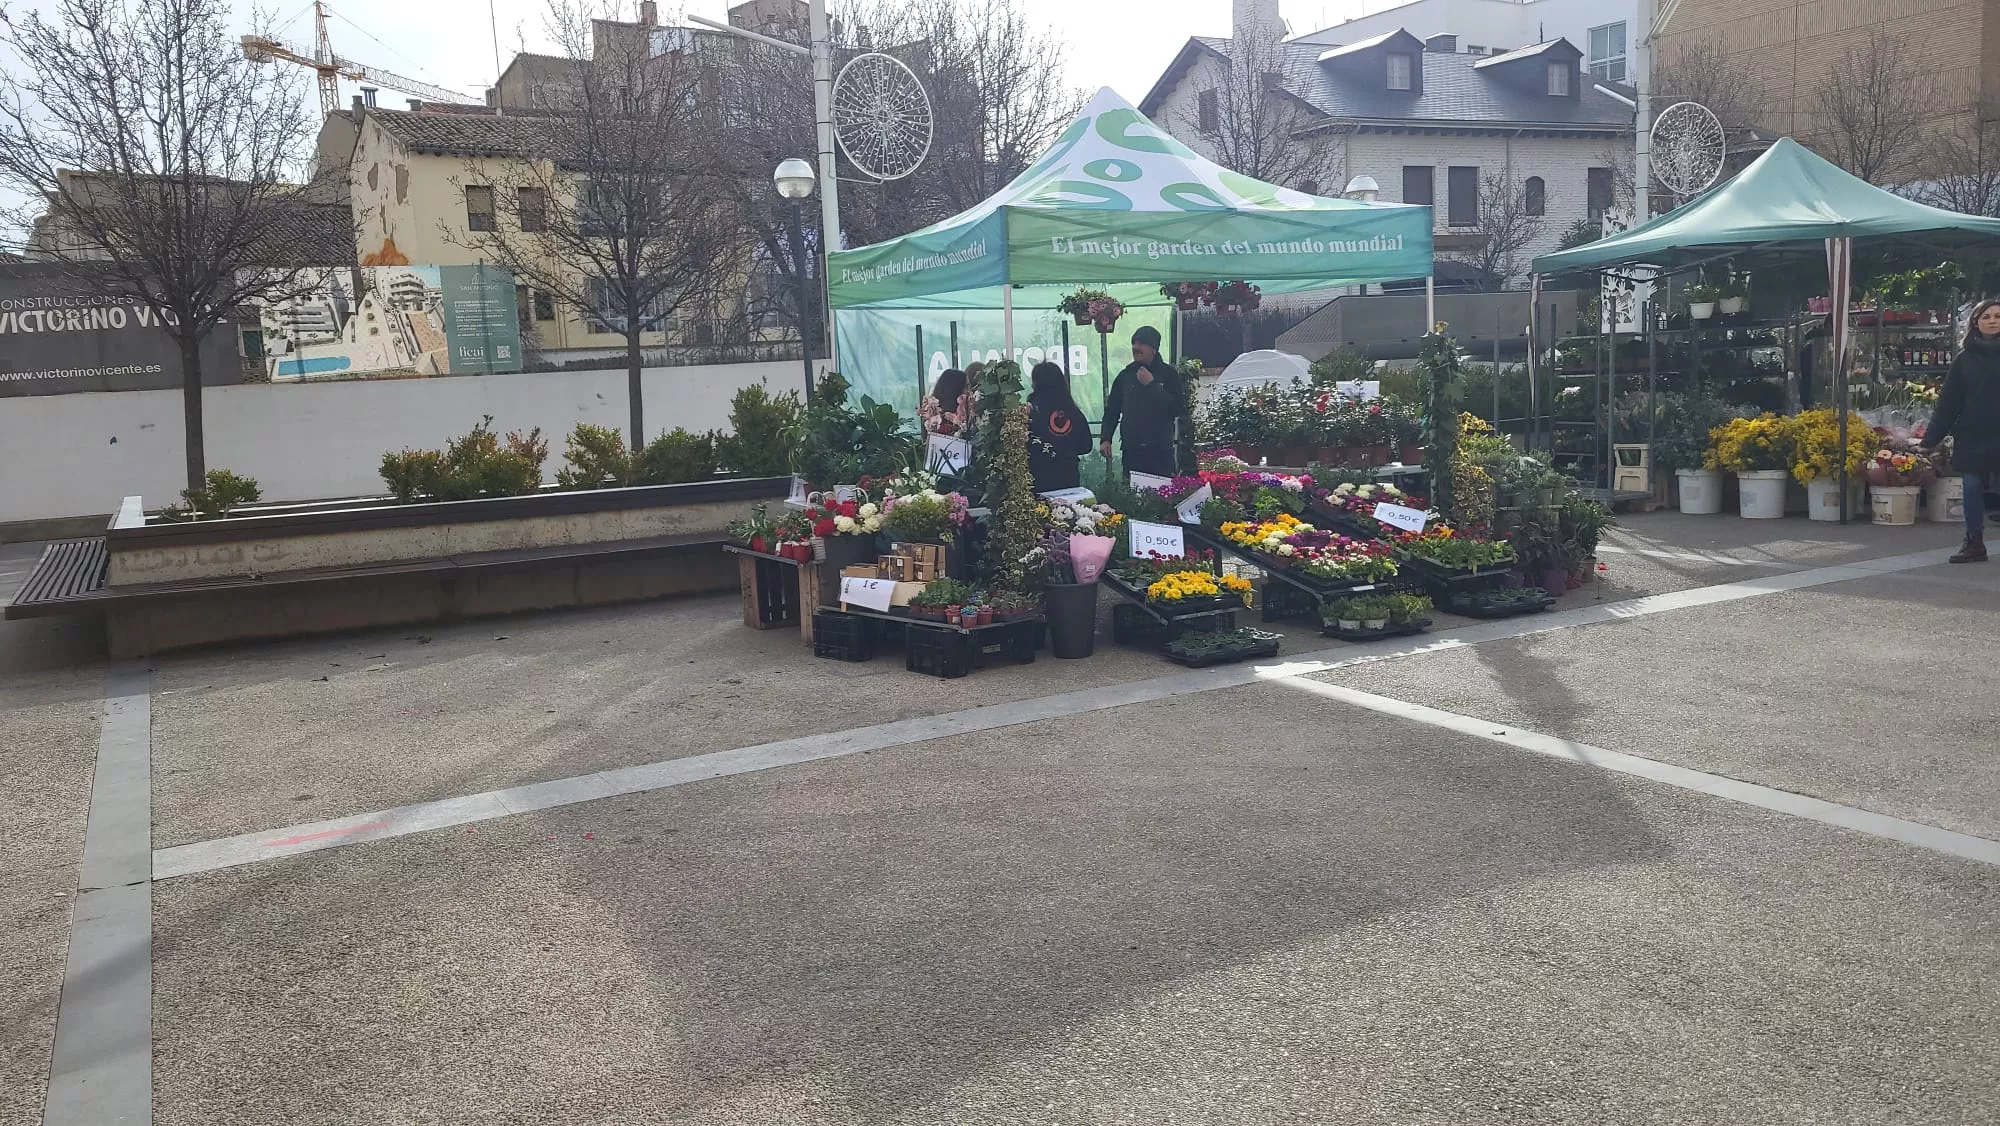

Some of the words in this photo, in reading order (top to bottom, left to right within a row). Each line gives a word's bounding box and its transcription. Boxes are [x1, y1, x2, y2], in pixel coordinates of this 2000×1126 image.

[1052, 236, 1076, 254] El
[1080, 237, 1142, 259] mejor
[1147, 239, 1217, 260] garden
[1221, 239, 1252, 254] del
[1256, 236, 1325, 255] mundo
[1328, 233, 1403, 252] mundial
[842, 268, 852, 283] El
[852, 265, 875, 284] mejor
[875, 260, 901, 282] garden
[902, 255, 915, 272] del
[915, 252, 948, 271] mundo
[949, 237, 987, 265] mundial
[0, 363, 161, 381] www.victorinovicente.es
